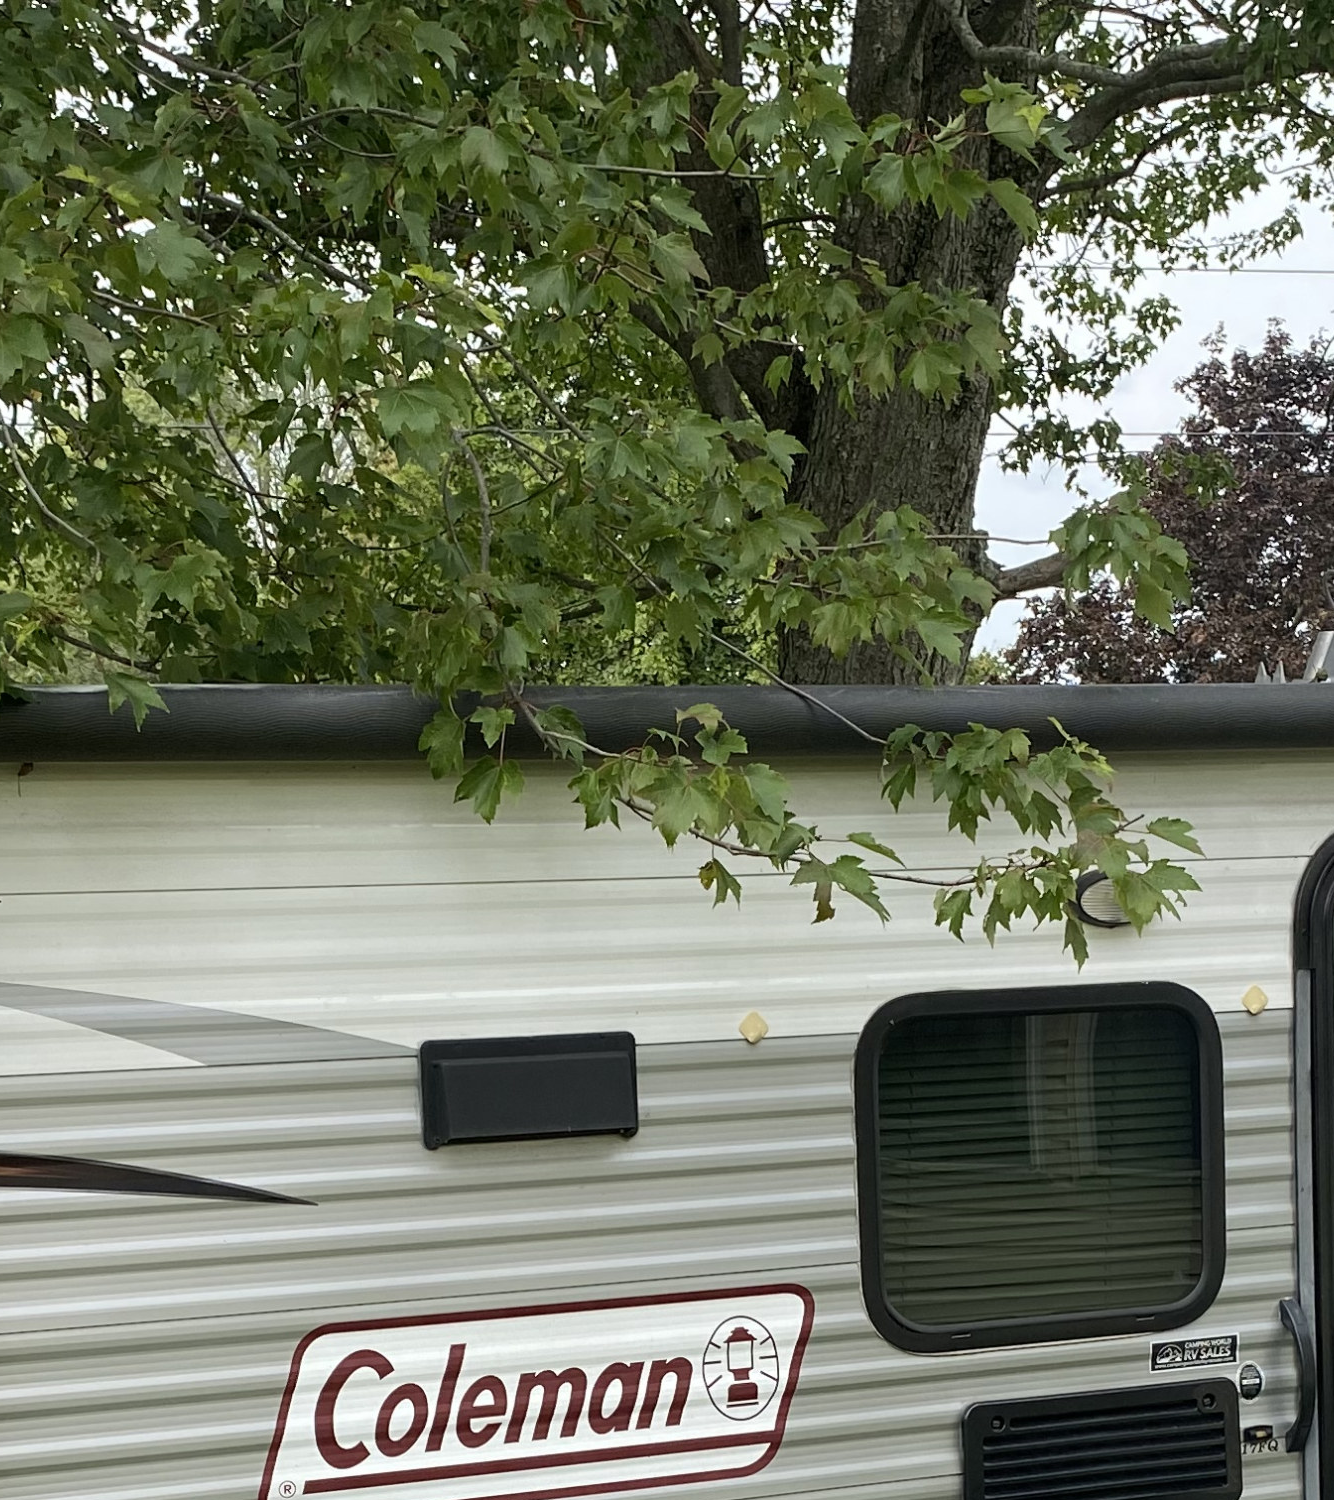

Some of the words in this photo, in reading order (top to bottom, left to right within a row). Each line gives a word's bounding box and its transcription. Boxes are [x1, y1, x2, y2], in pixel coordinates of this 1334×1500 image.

[1184, 1340, 1210, 1349] CAMPING
[1211, 1337, 1233, 1346] WORLD
[1183, 1348, 1199, 1361] RV
[1199, 1346, 1232, 1360] SALES
[313, 1342, 694, 1470] Coleman
[1241, 1439, 1279, 1455] 17FQ
